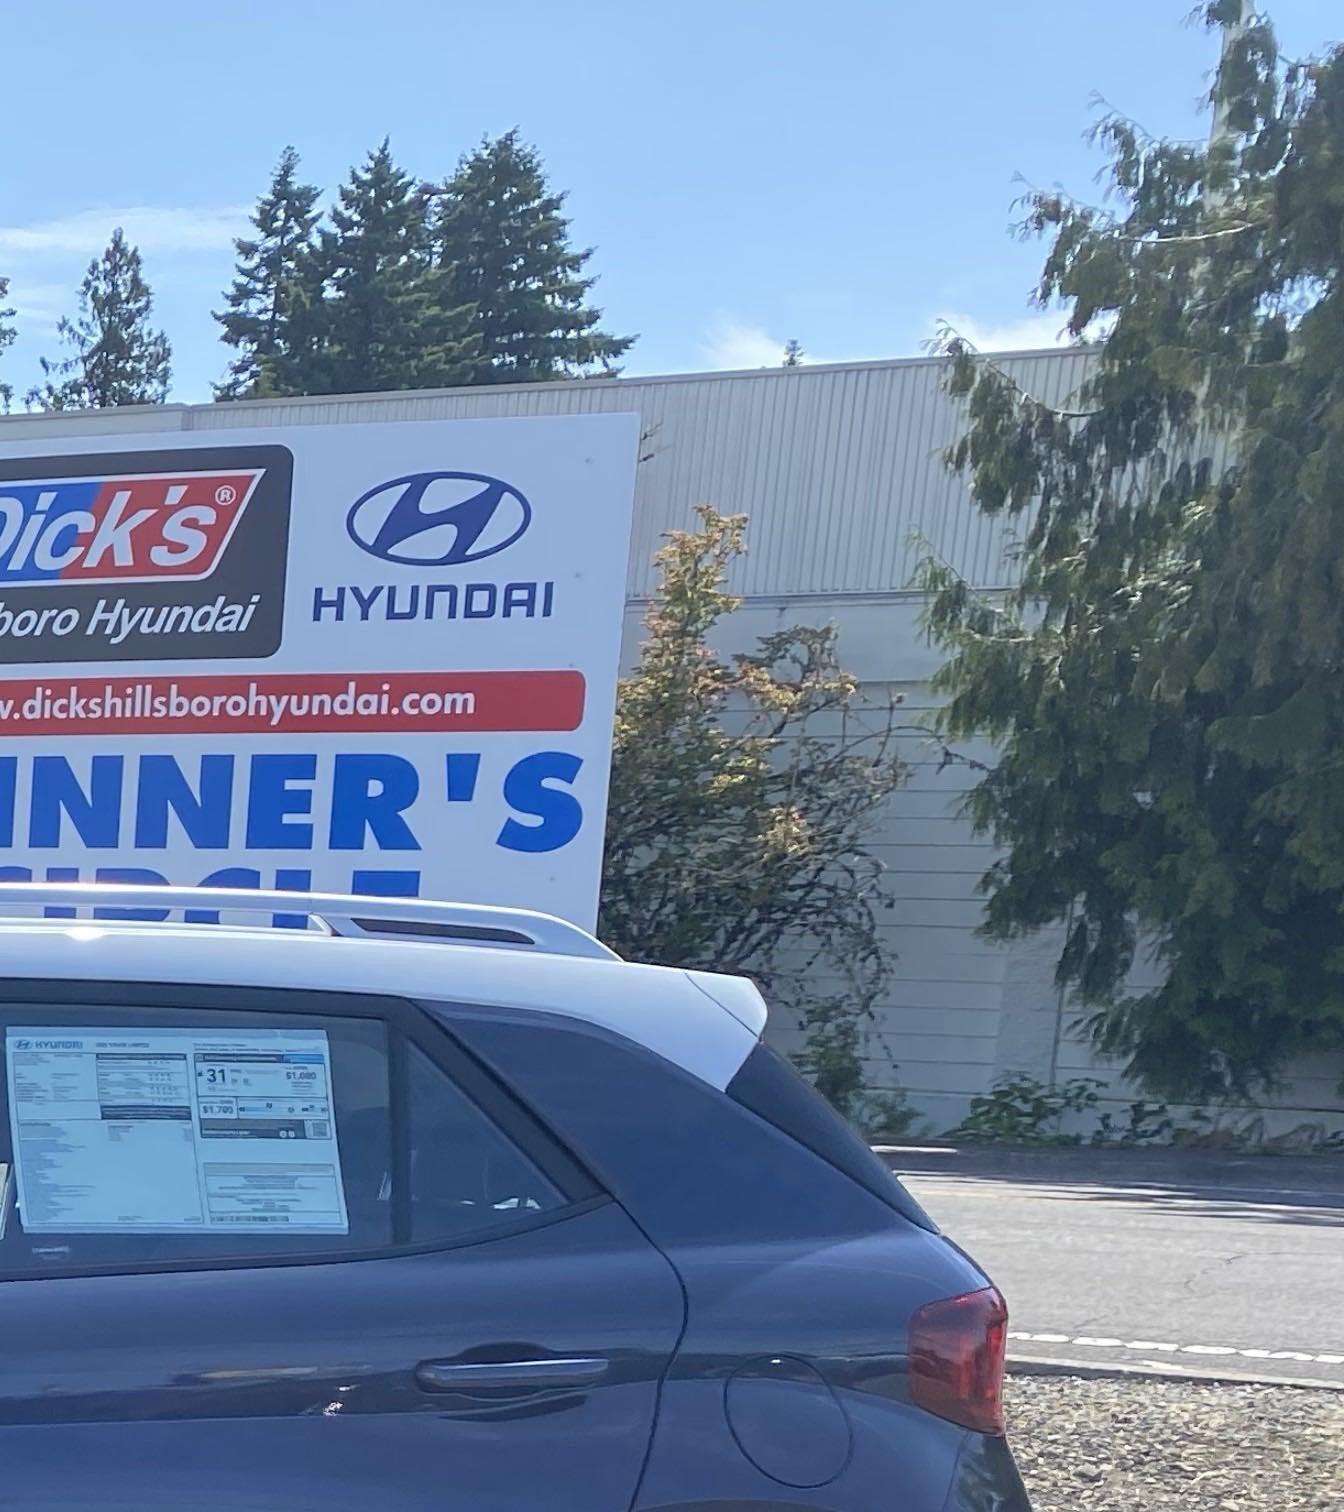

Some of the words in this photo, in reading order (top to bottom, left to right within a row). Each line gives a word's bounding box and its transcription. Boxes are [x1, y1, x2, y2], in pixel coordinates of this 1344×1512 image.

[86, 594, 261, 645] Hyundai
[314, 583, 553, 621] HYUNDAI
[207, 1068, 226, 1083] 31
